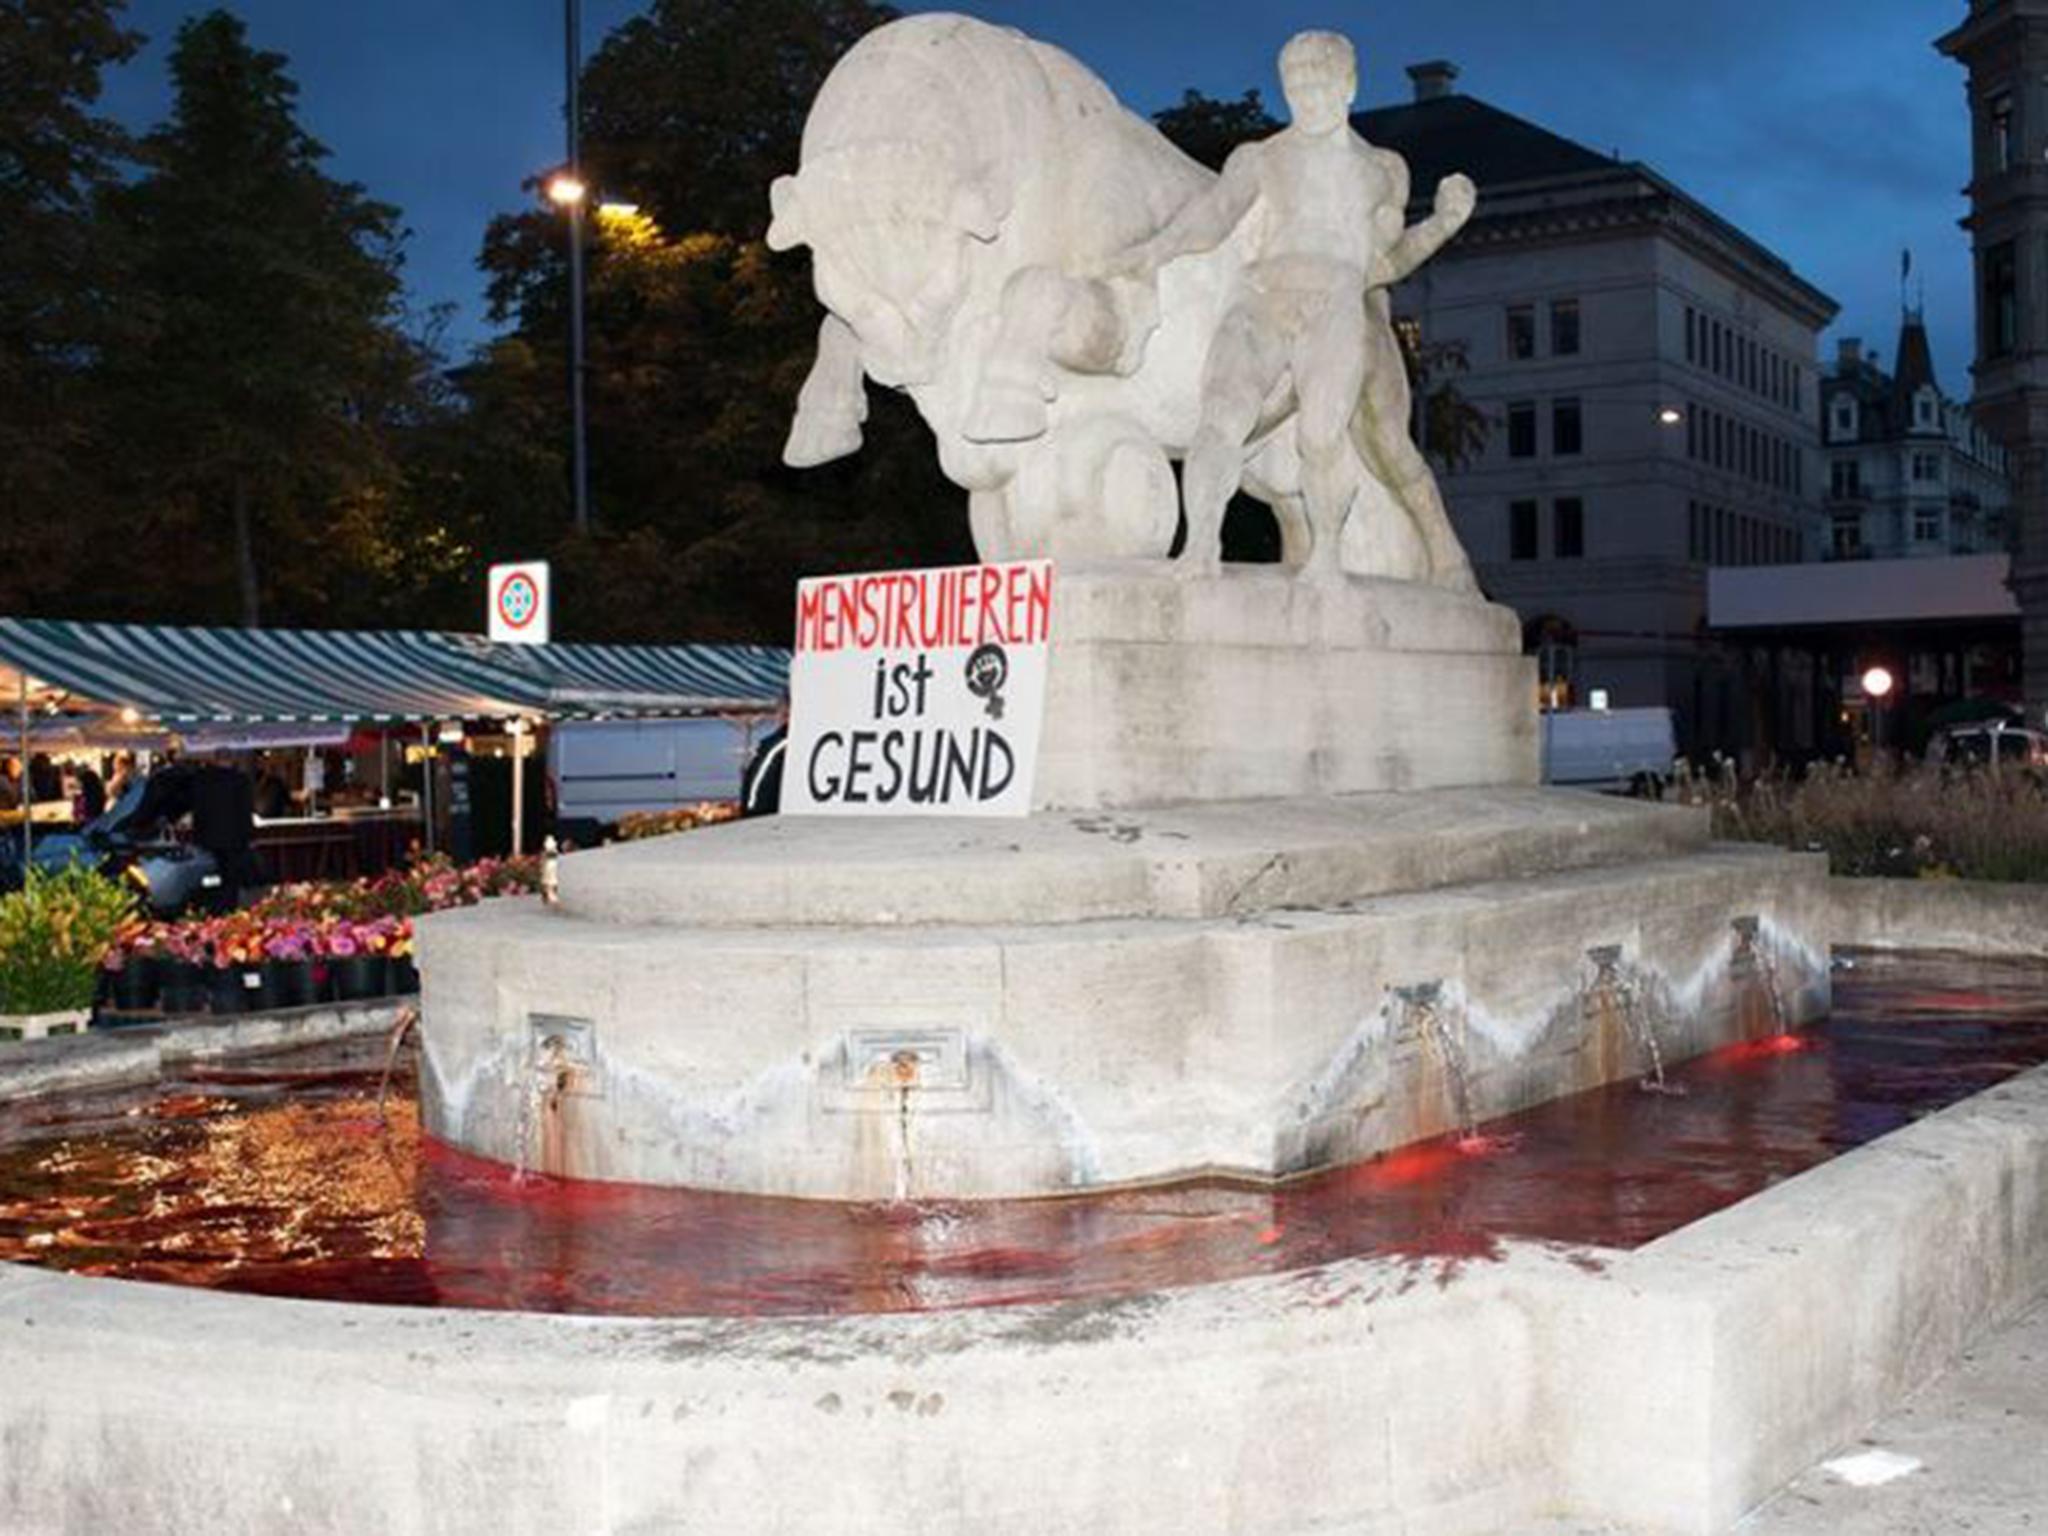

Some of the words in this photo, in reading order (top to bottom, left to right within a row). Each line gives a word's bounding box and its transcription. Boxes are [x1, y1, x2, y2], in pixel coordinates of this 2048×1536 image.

[799, 565, 1051, 650] MENSTRUIEREN
[875, 654, 932, 718] ist
[809, 728, 1014, 803] GESUND
